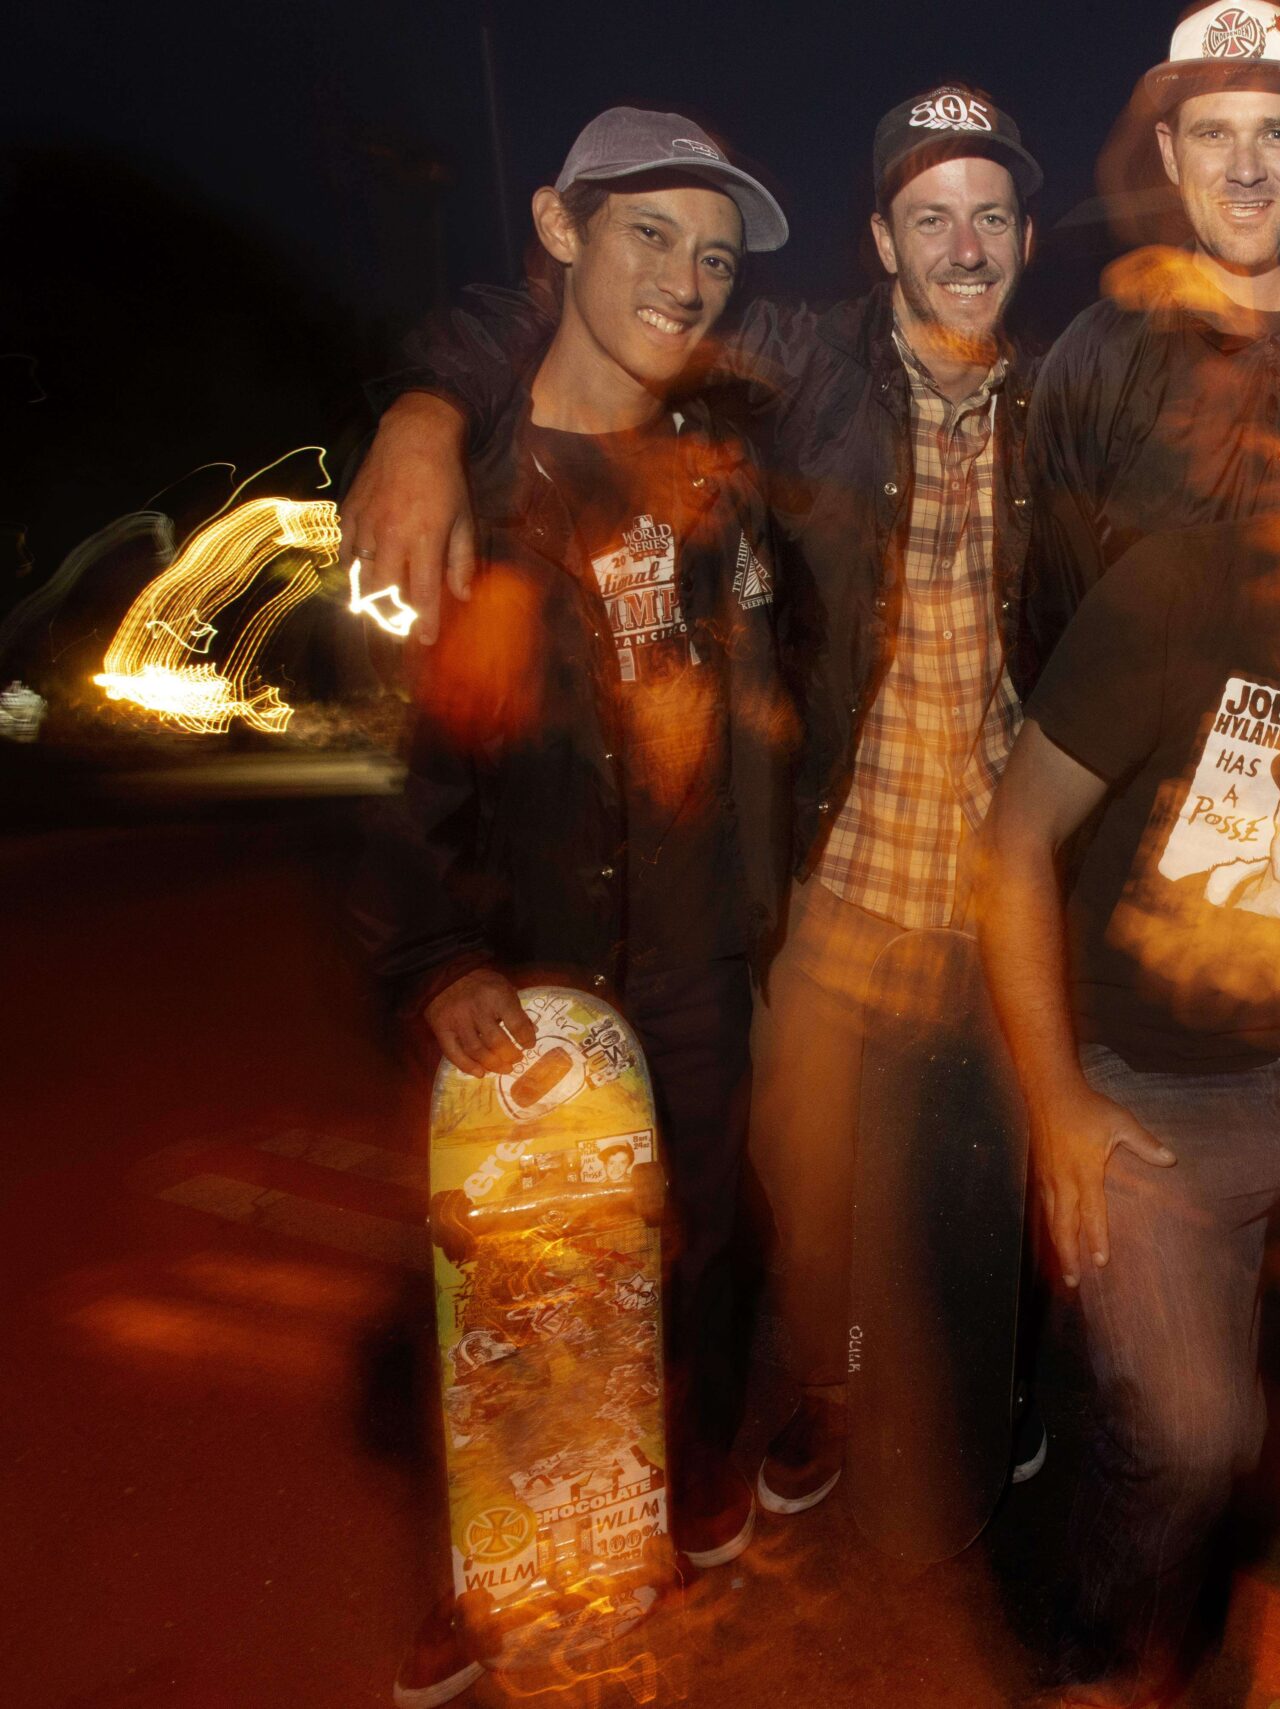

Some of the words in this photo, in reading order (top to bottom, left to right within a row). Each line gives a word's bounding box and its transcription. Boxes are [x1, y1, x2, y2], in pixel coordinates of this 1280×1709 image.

[909, 94, 992, 131] 805
[622, 524, 671, 545] WORLD
[629, 537, 669, 556] SERIES
[1216, 749, 1261, 777] HAS
[1222, 784, 1240, 808] A
[597, 1498, 660, 1534] WLLM
[465, 1560, 536, 1592] WLLM
